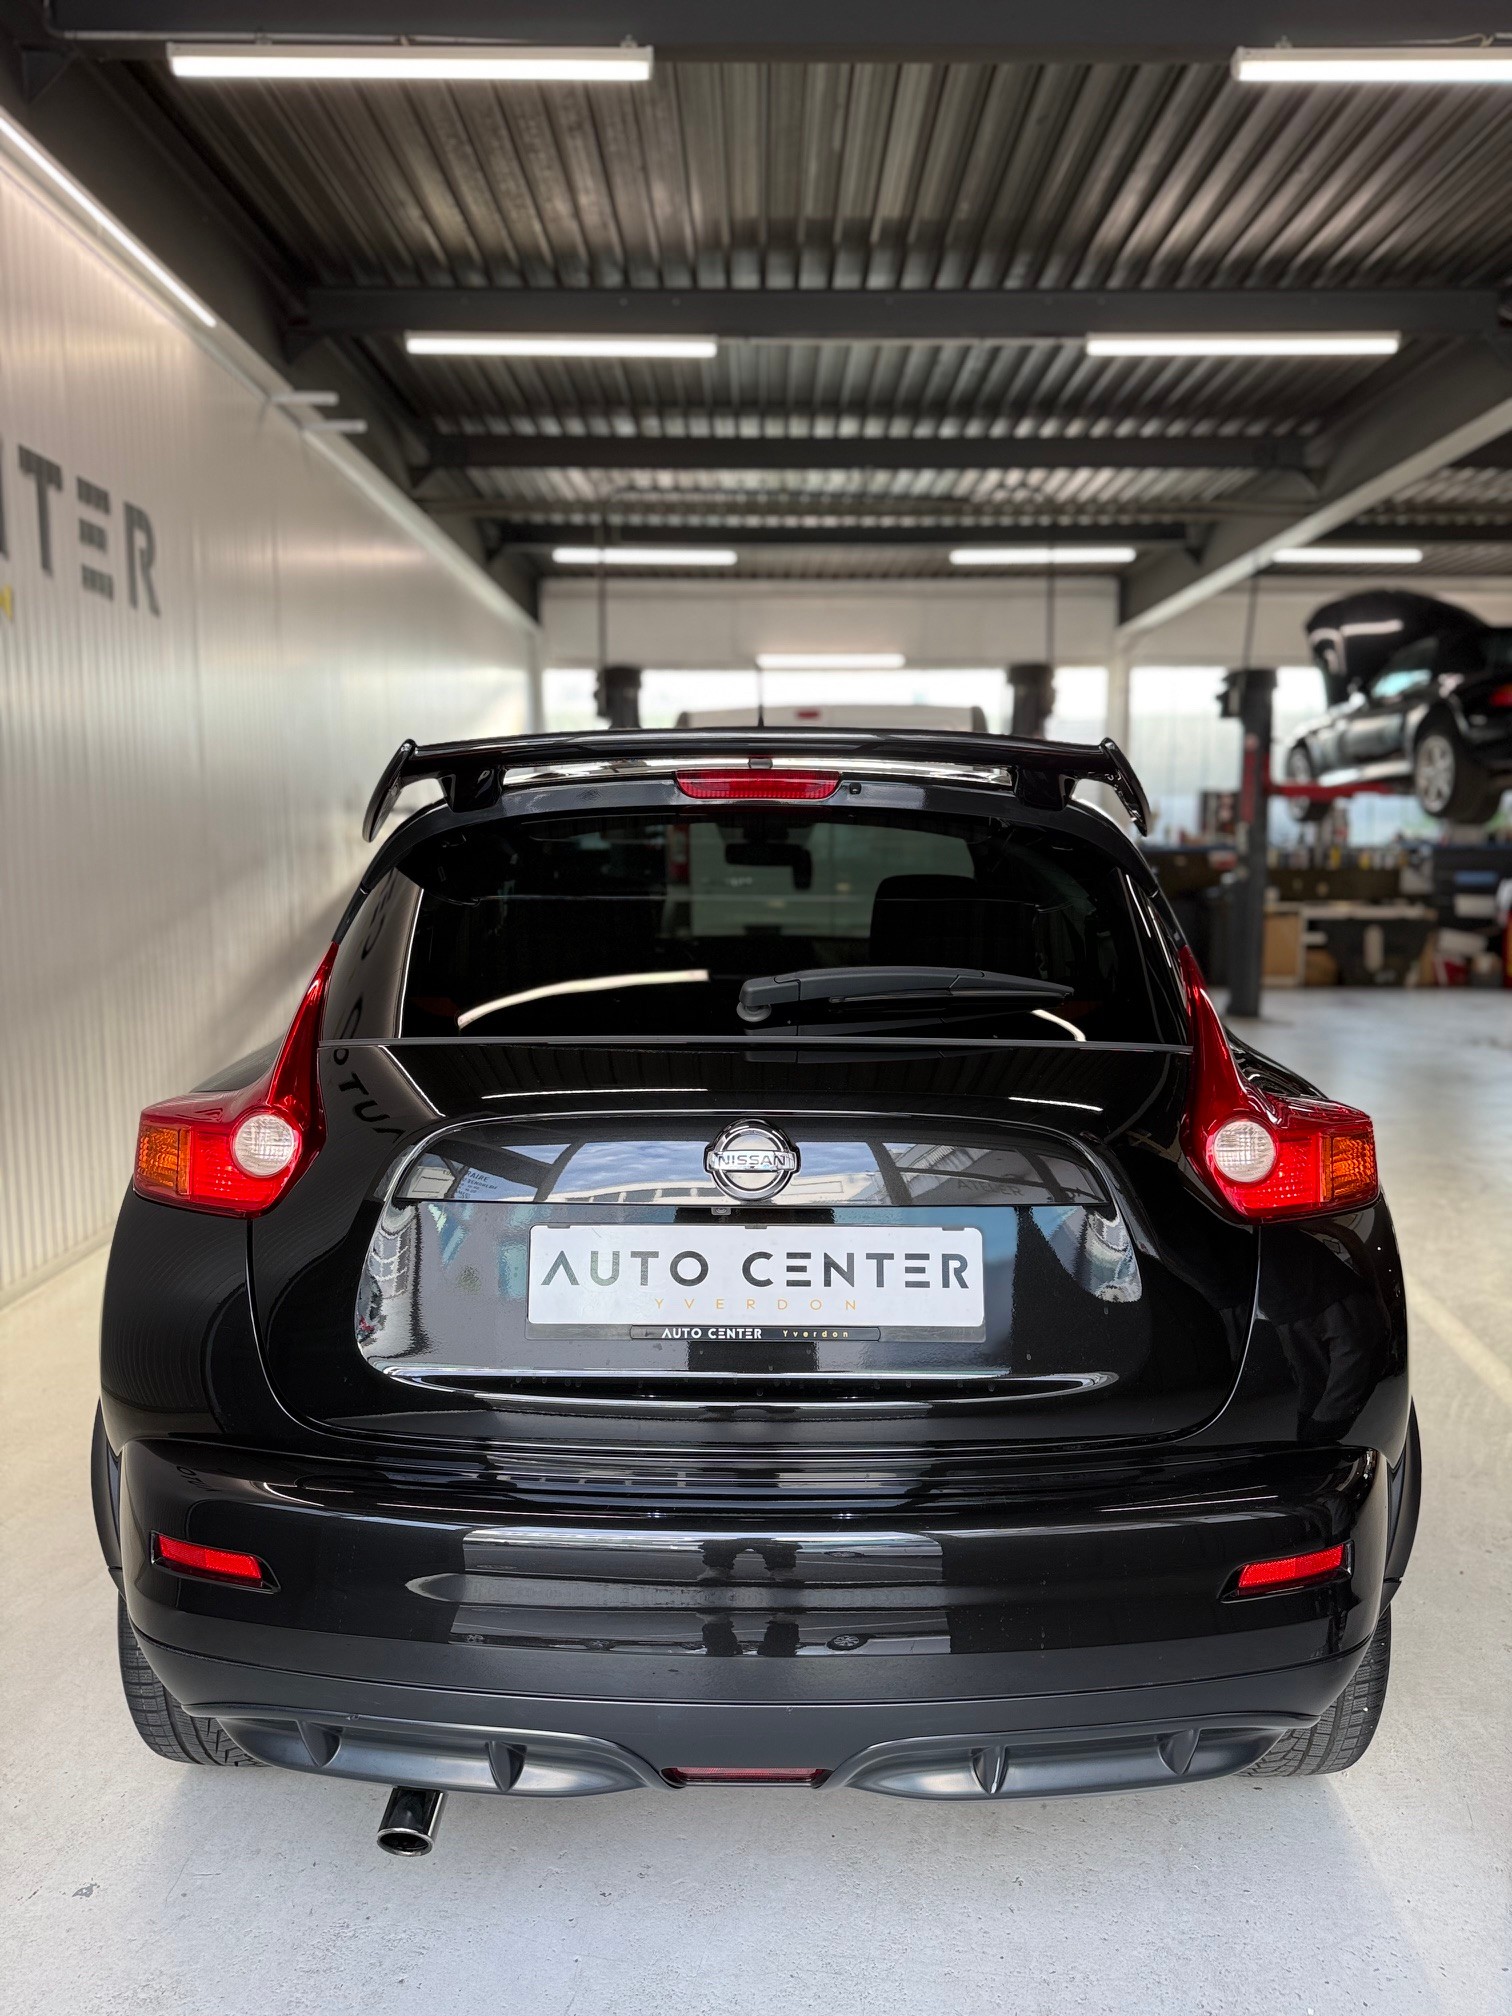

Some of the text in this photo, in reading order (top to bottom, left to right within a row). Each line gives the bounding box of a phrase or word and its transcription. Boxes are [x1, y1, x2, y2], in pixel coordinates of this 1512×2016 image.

[0, 432, 161, 619] TER
[718, 1154, 786, 1166] NISSAN
[541, 1250, 970, 1290] AUTO CENTER
[655, 1297, 857, 1312] YVERDON
[661, 1327, 849, 1340] AUTO CENTER Yverdon
